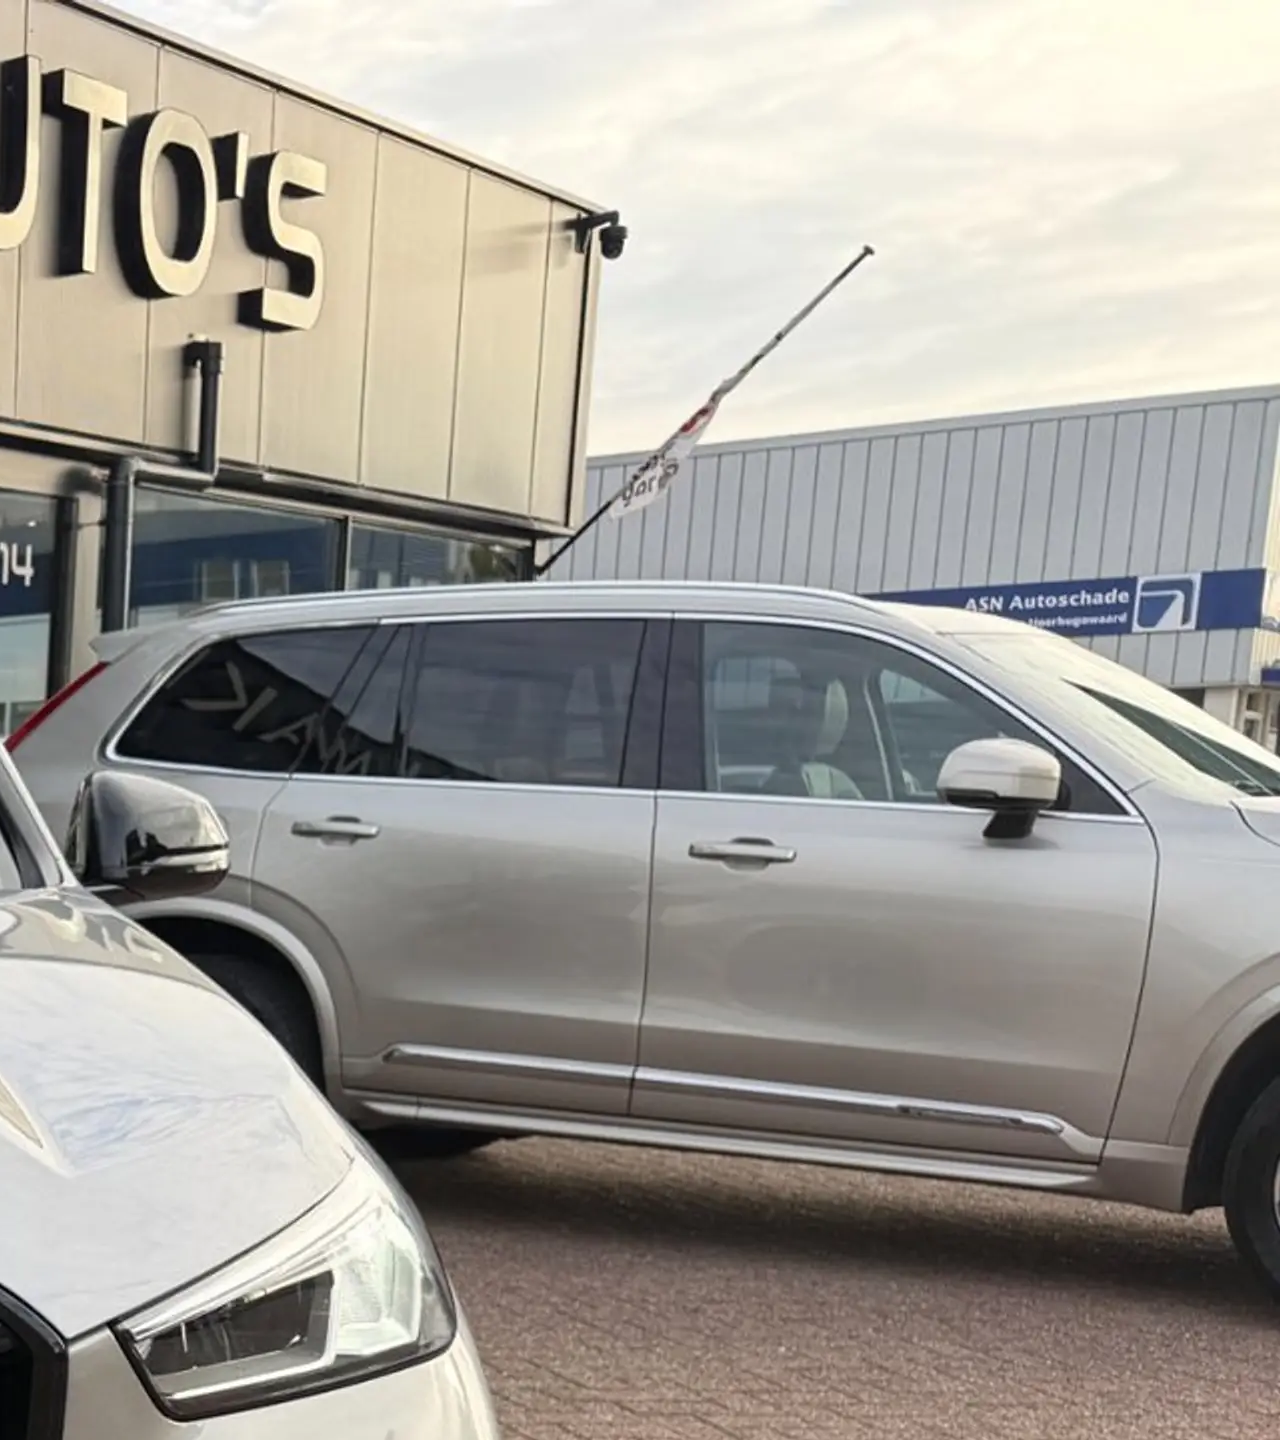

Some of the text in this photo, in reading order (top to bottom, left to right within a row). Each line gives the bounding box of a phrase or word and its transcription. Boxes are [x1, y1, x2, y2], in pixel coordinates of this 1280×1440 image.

[0, 541, 34, 588] 14
[965, 586, 1130, 612] ASN Autoschade
